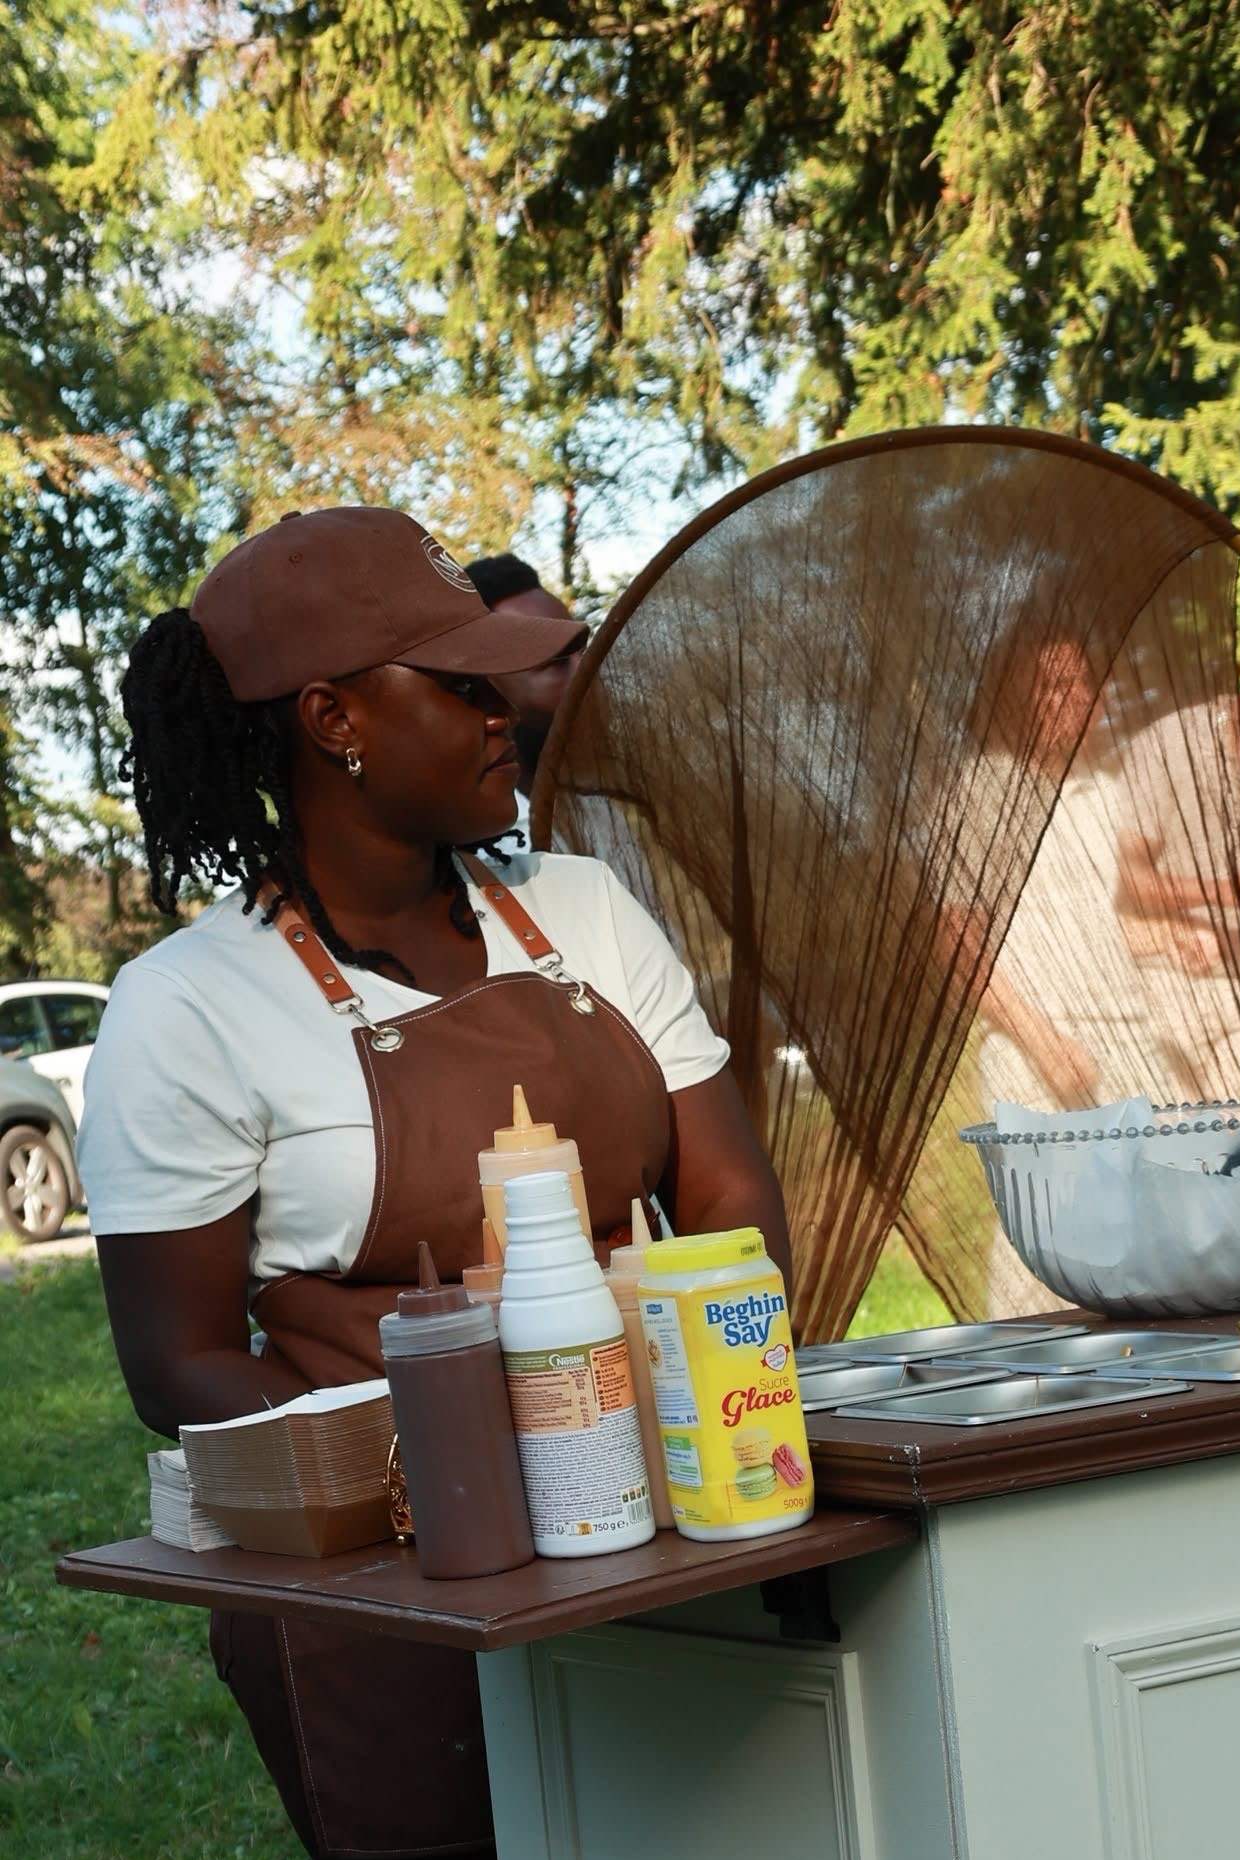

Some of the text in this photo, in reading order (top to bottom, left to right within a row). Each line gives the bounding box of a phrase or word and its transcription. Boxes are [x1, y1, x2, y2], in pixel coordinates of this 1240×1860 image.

[704, 1292, 784, 1325] Béghin
[724, 1315, 773, 1347] Say
[759, 1376, 790, 1392] Sucre
[721, 1386, 796, 1427] Glace
[592, 1522, 609, 1532] 750
